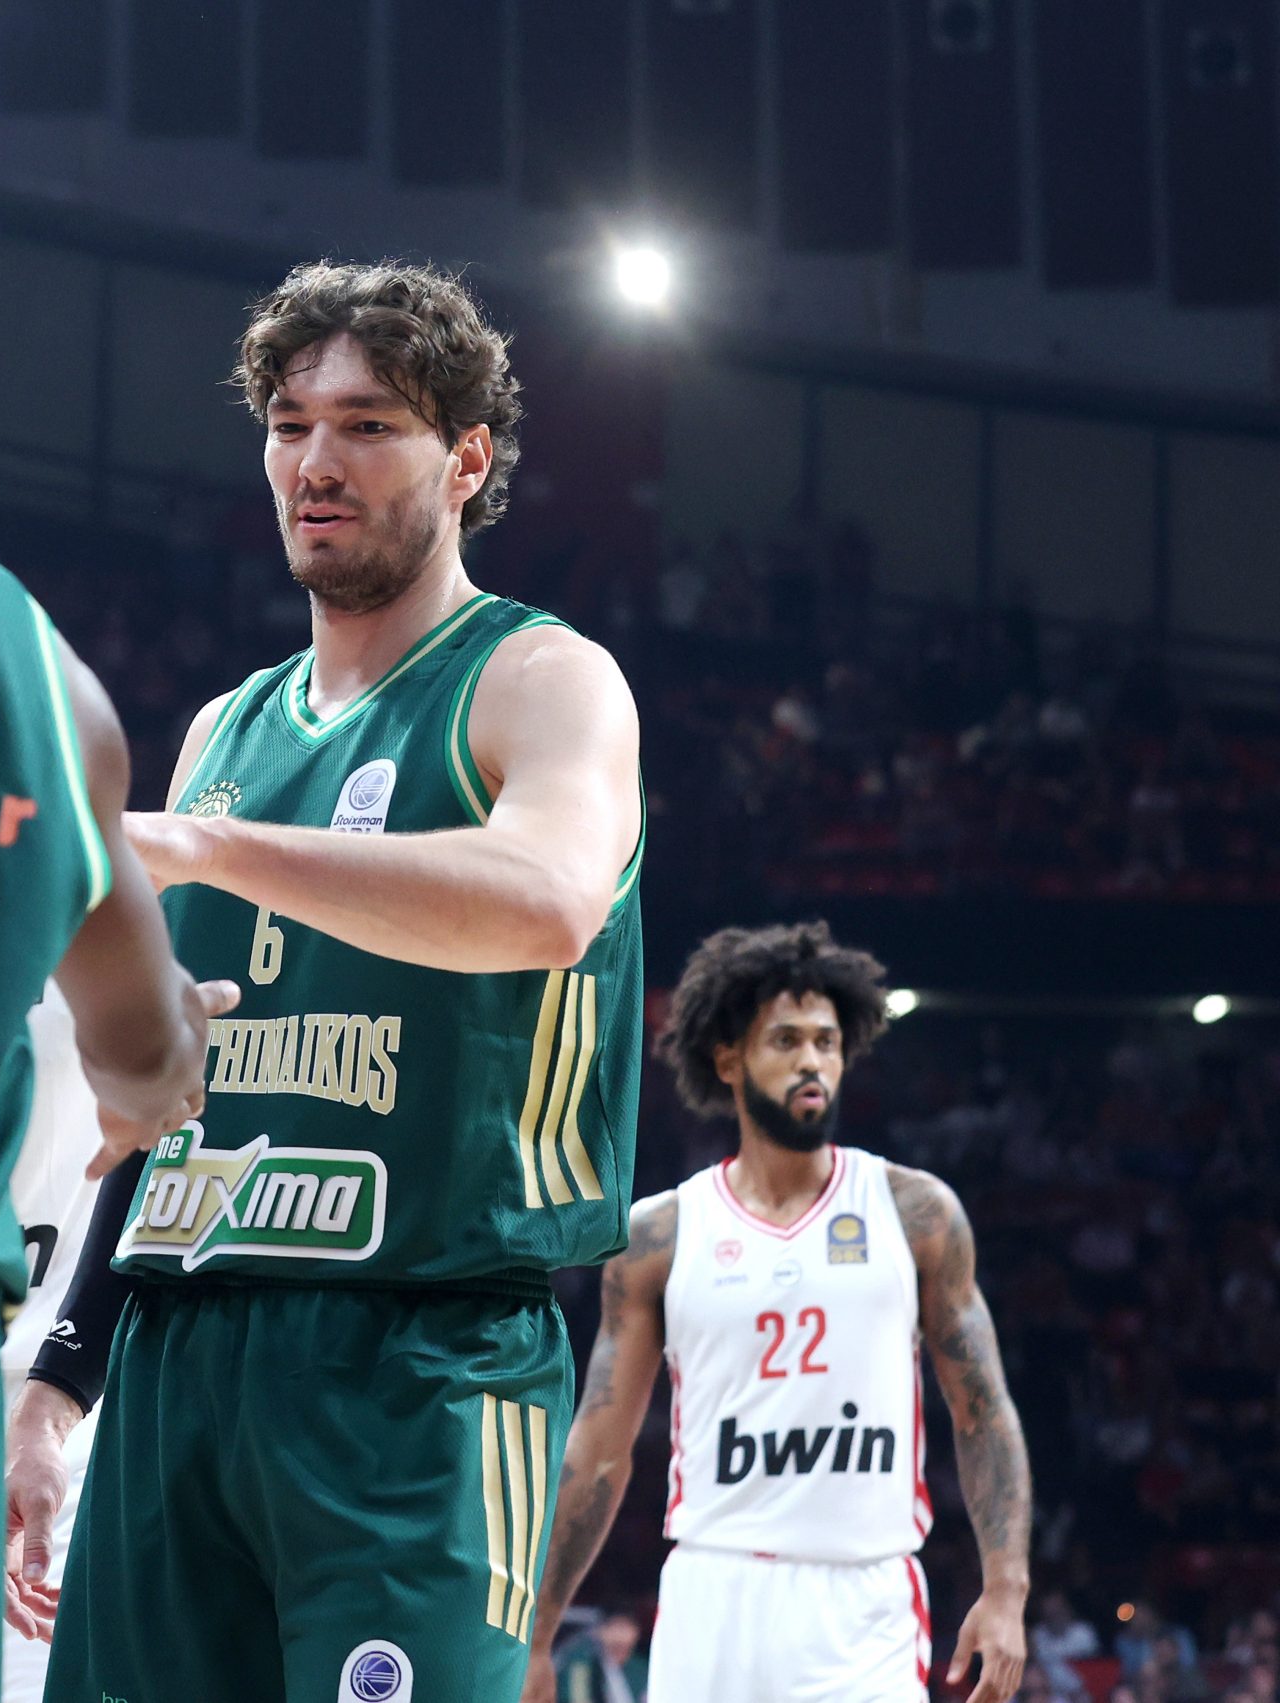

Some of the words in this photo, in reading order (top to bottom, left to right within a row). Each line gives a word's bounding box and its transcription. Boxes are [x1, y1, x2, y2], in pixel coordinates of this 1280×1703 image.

[333, 814, 383, 826] Stoiximan
[249, 905, 284, 985] 6
[755, 1306, 828, 1380] 22
[716, 1401, 896, 1485] bwin
